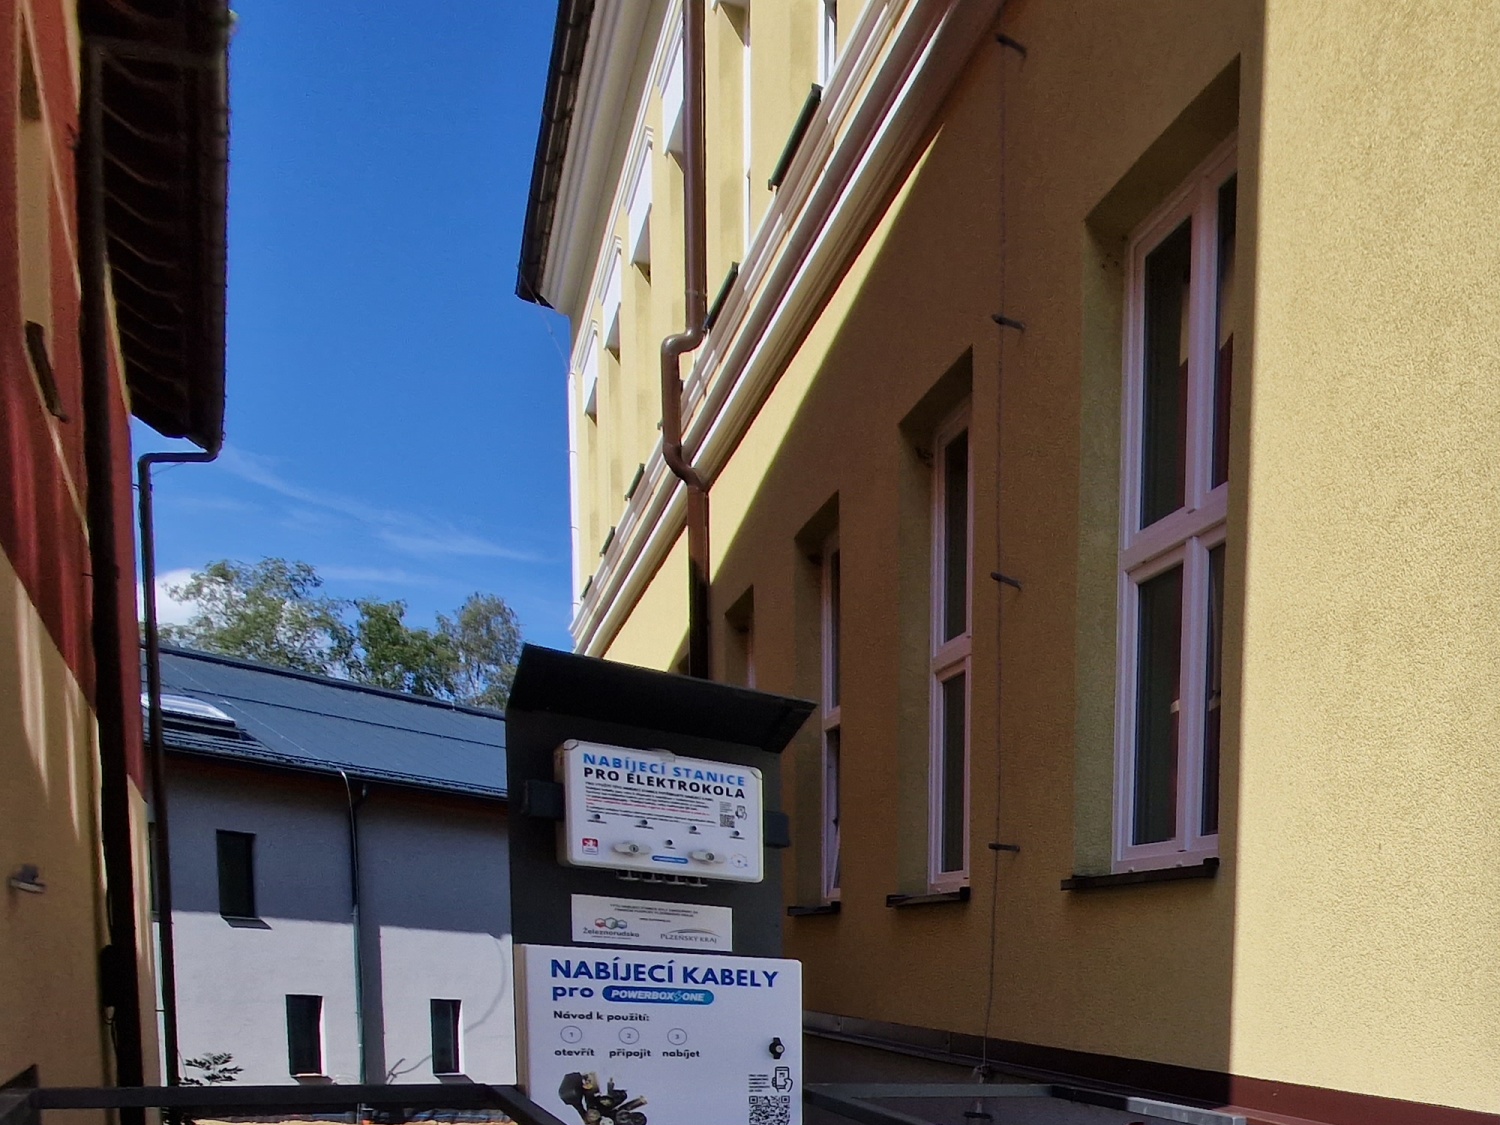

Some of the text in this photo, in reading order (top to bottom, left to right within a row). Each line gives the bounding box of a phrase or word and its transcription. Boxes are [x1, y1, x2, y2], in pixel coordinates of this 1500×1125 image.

[583, 753, 745, 786] NABÍJECÍ STANICE
[584, 767, 745, 799] PRO ELEKTROKOLA
[700, 936, 717, 944] KRAJ
[551, 957, 779, 988] NABÍJECÍ KABELY
[552, 986, 594, 1001] pro
[553, 1010, 650, 1022] Návod k použití:
[554, 1048, 595, 1057] otevřít
[609, 1049, 651, 1058] připojit
[662, 1050, 701, 1059] nabíjet
